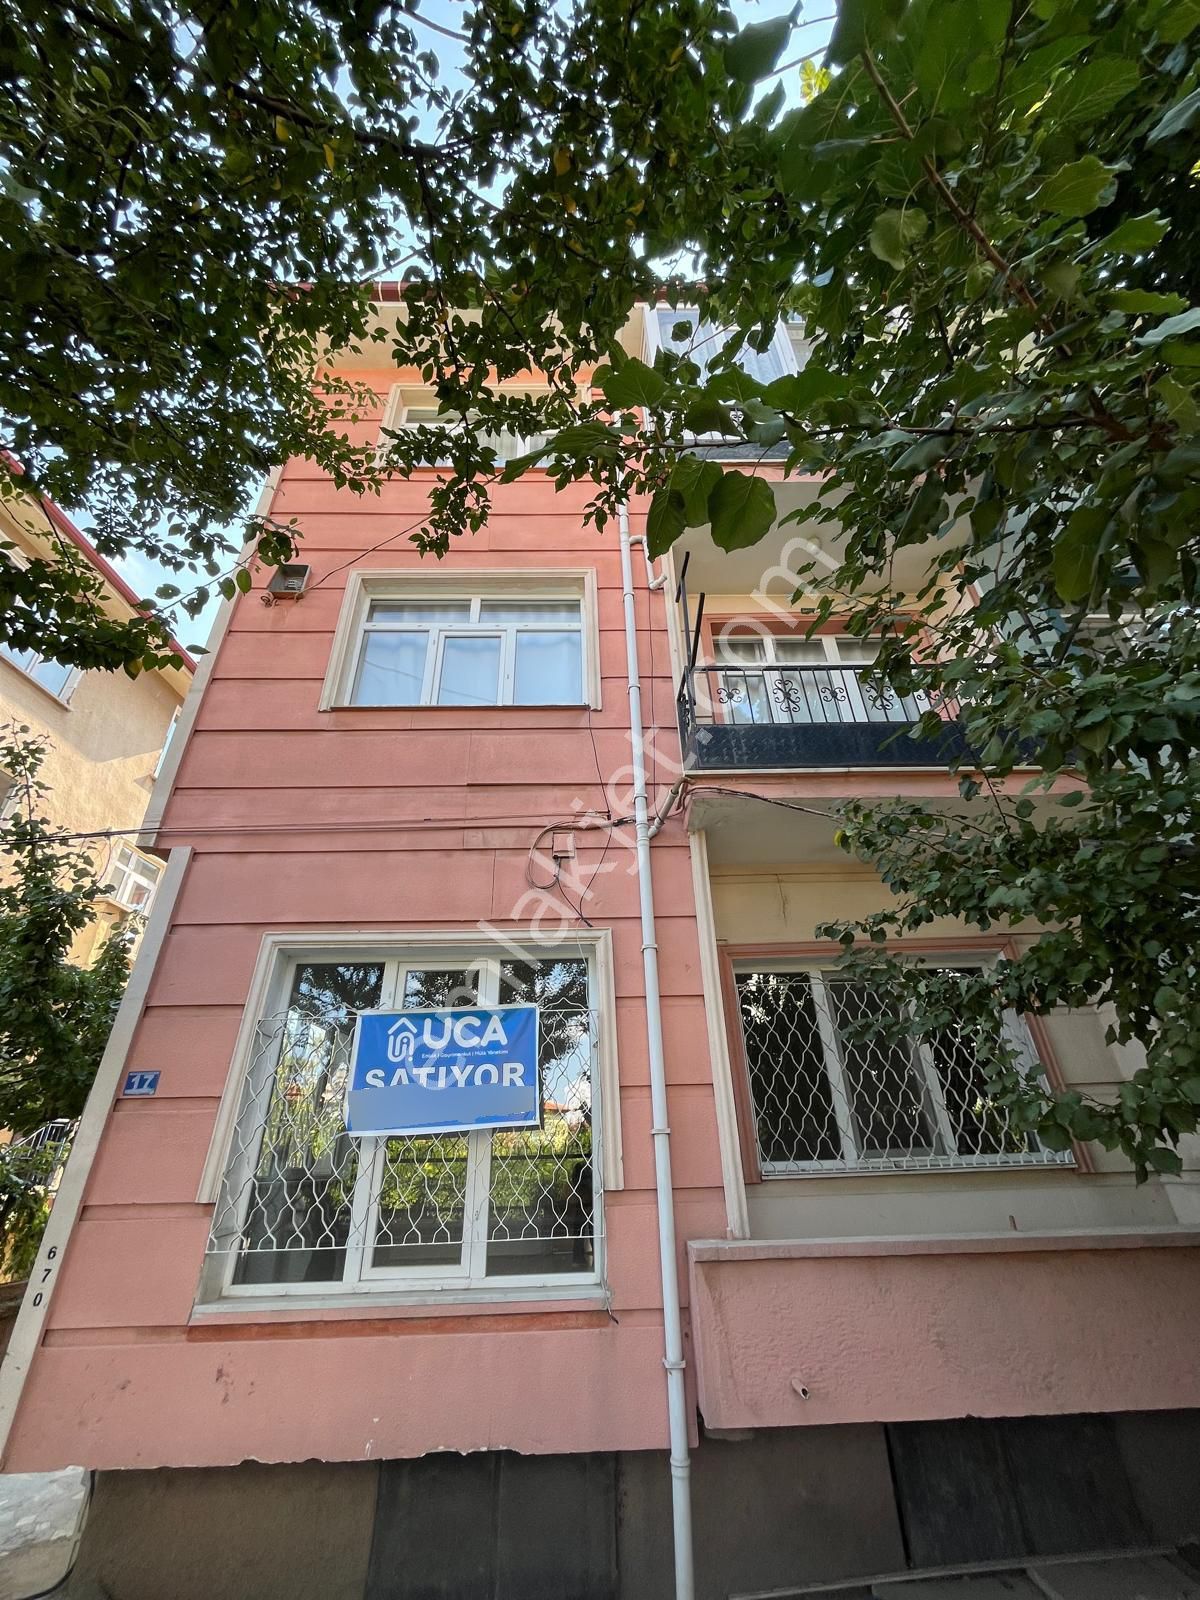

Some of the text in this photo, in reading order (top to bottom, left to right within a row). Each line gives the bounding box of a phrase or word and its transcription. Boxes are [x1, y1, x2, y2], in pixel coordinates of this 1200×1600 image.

[422, 1015, 508, 1050] UCA
[131, 1074, 155, 1090] 17
[365, 1062, 526, 1089] SATIYOR
